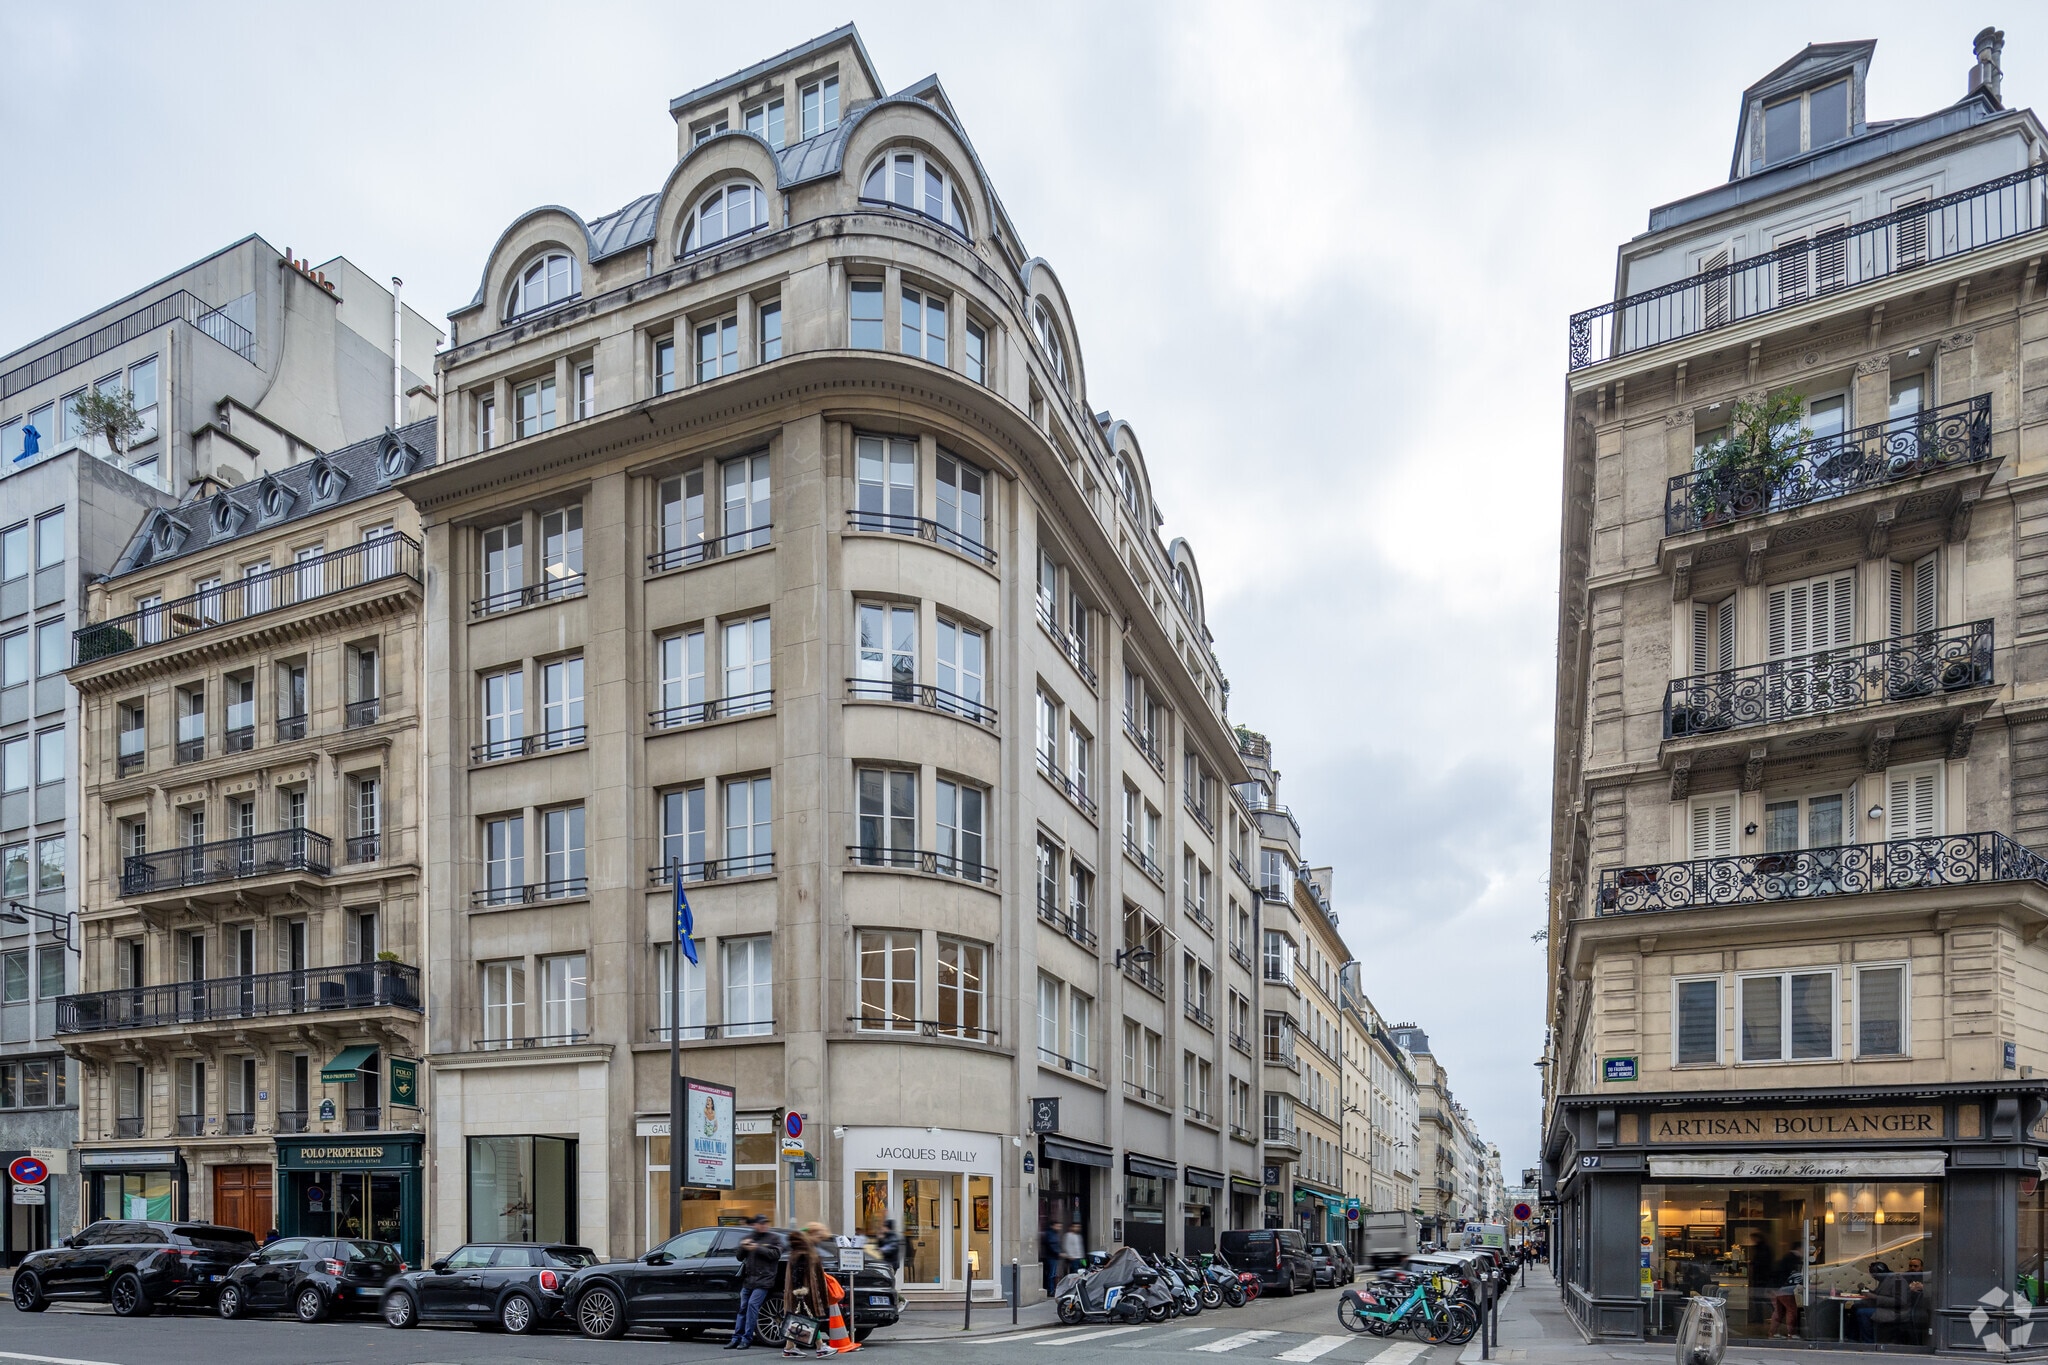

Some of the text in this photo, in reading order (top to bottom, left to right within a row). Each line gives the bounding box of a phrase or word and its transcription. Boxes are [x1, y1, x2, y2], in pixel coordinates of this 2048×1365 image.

[395, 1068, 412, 1076] POLO
[735, 1122, 756, 1132] AILLY
[1659, 1113, 1934, 1136] ARTISAN BOULANGER
[301, 1146, 384, 1159] POLO PROPERTIES
[876, 1147, 977, 1163] JACQUES BAILLY
[1582, 1156, 1599, 1167] 97
[1749, 1163, 1791, 1176] Saint
[1794, 1164, 1849, 1176] Honoré
